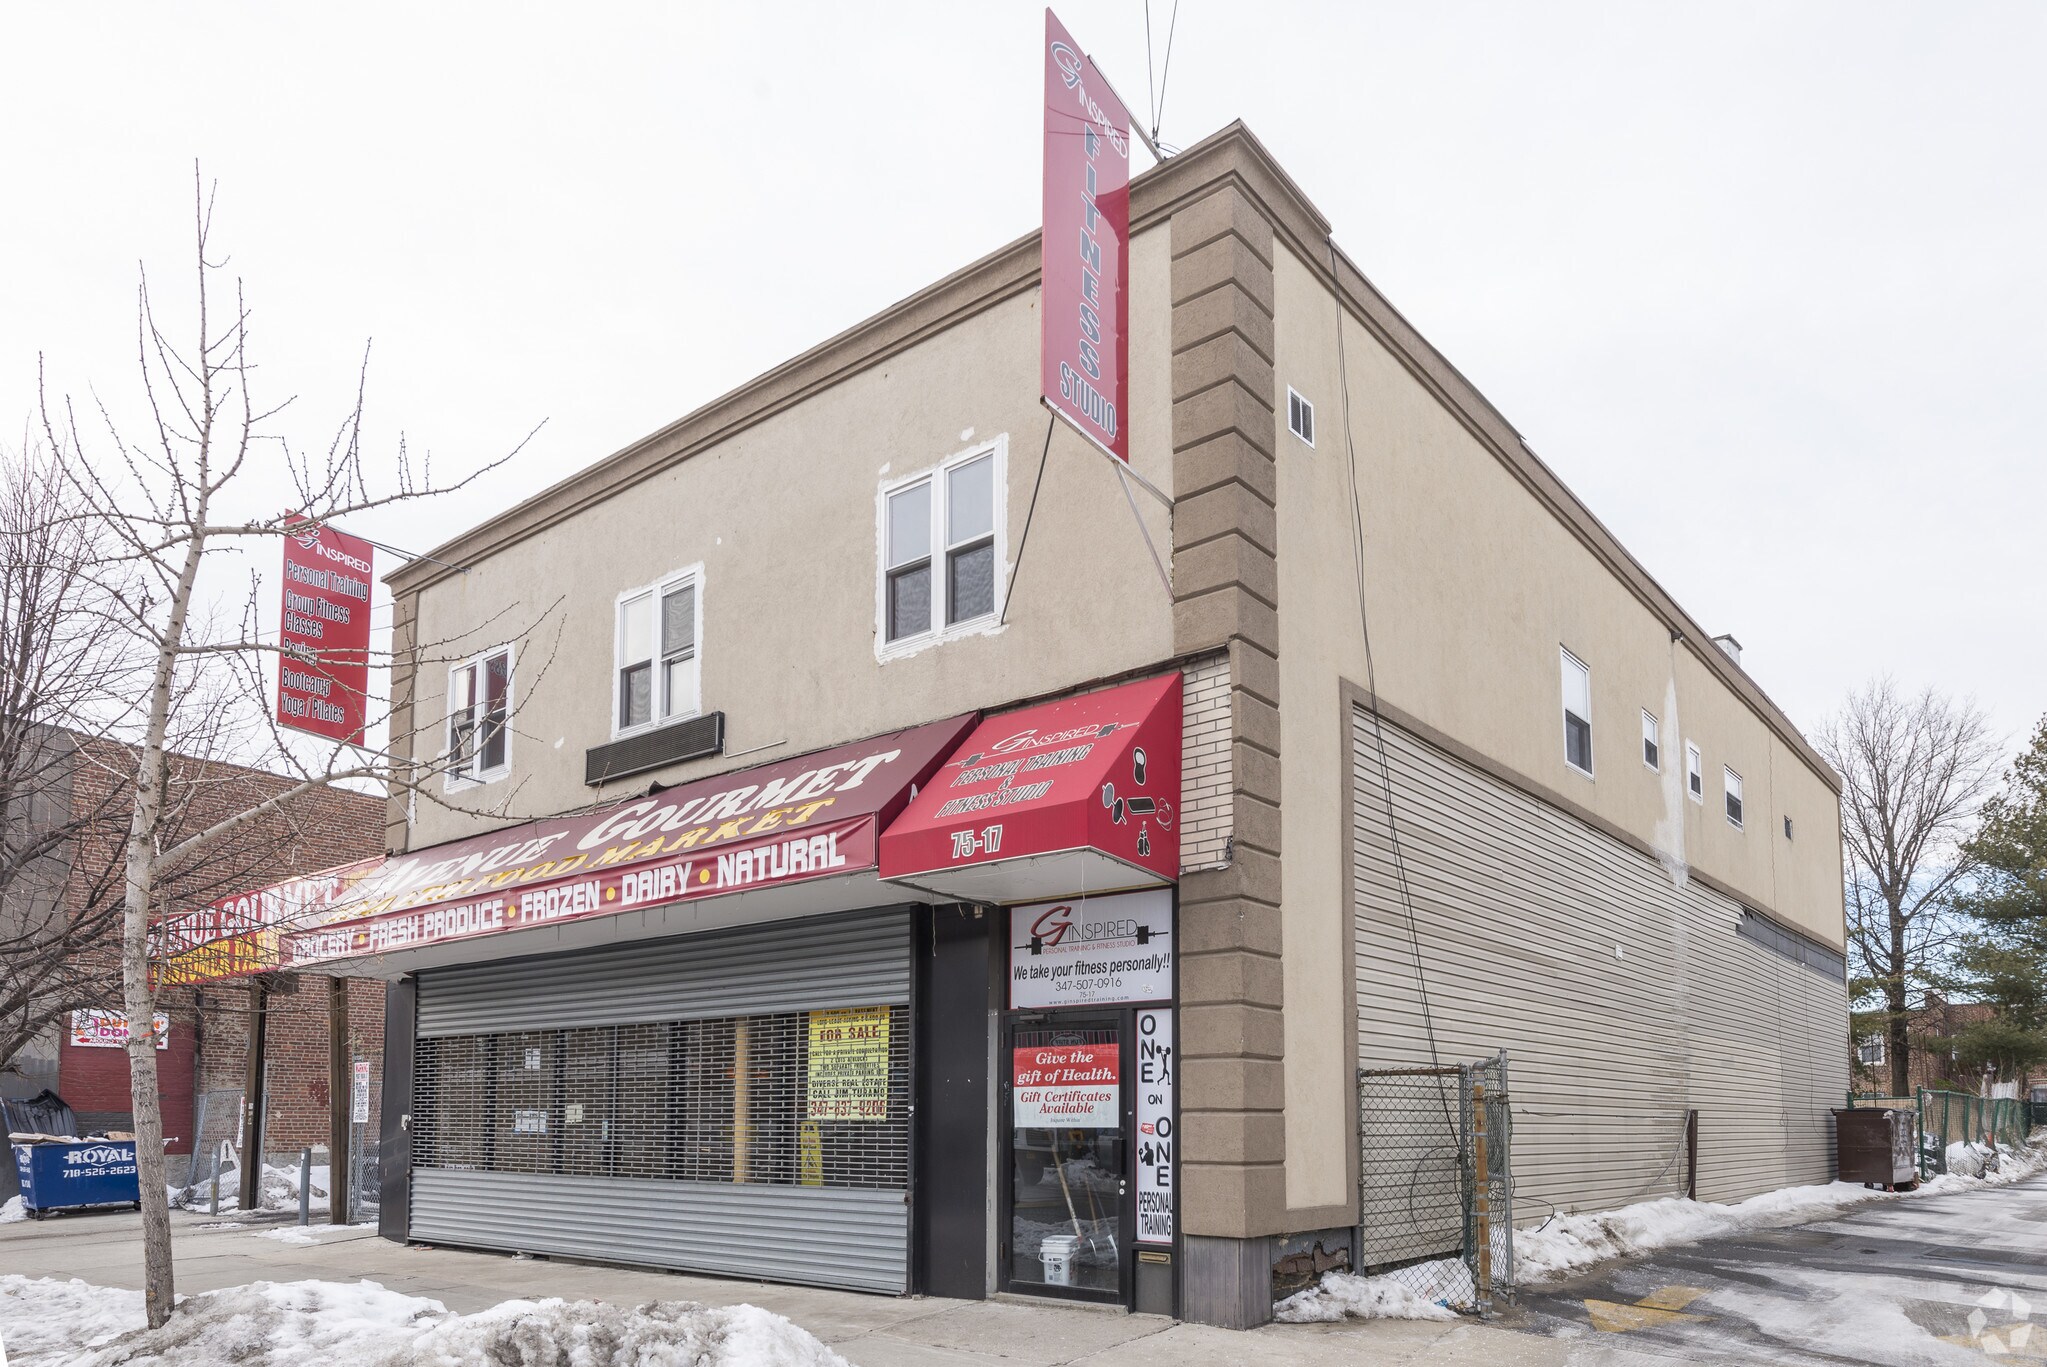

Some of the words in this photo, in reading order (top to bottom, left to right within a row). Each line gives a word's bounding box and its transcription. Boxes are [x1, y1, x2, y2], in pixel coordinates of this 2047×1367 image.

[1079, 122, 1101, 381] FITNESS
[1060, 361, 1117, 438] STUDIO
[286, 559, 329, 589] Personal
[330, 570, 369, 602] Training
[286, 589, 315, 616] Group
[316, 596, 350, 624] Fitness
[285, 611, 323, 638] Classes
[282, 667, 331, 697] Bootcamp
[281, 692, 304, 718] Yoga
[312, 699, 345, 724] Pilates
[950, 758, 1025, 788] PERSONAL
[1021, 743, 1095, 772] TRAINING
[998, 775, 1014, 790] &
[935, 792, 998, 818] FITNESS
[993, 779, 1055, 807] STUDIO
[340, 831, 570, 905] AVENUE
[577, 749, 901, 850] GOURMET
[586, 798, 836, 868] MARKET
[951, 824, 1003, 858] 75-17
[293, 927, 354, 963] GROCERY
[369, 915, 419, 950] FRESH
[423, 899, 503, 940] PRODUCE
[521, 880, 600, 922] FROZEN
[621, 862, 693, 906] DAIRY
[717, 832, 845, 888] NATURAL
[1043, 946, 1067, 954] PERSONAL
[1068, 944, 1091, 953] TRAINING
[1097, 941, 1116, 950] FITNESS
[1117, 940, 1136, 949] STUDIO
[1014, 965, 1028, 981] We
[1030, 963, 1050, 979] take
[1050, 964, 1073, 981] your
[1074, 960, 1108, 976] fitness
[1110, 953, 1170, 976] personally!!
[1056, 977, 1122, 992] 347-507-0916
[1049, 995, 1130, 1005] www.ginspiredtraining.com
[820, 1029, 842, 1042] FOR
[848, 1025, 879, 1039] SALE
[1036, 1052, 1067, 1065] Give
[1070, 1051, 1094, 1063] the
[1140, 1014, 1156, 1083] ONE
[862, 1078, 886, 1086] ESTATE
[1017, 1070, 1042, 1085] gift
[1044, 1069, 1061, 1084] of
[1062, 1068, 1116, 1081] Health.
[813, 1089, 831, 1098] CALL
[834, 1089, 848, 1098] JIM
[1021, 1091, 1041, 1103] Gift
[1045, 1091, 1112, 1102] Certificates
[1148, 1094, 1162, 1105] ON
[1039, 1103, 1094, 1114] Available
[68, 1149, 133, 1164] ROYAL
[1156, 1117, 1172, 1187] ONE
[63, 1166, 136, 1178] 718-526-2623
[1139, 1191, 1172, 1214] PERSONAL
[1140, 1213, 1172, 1236] TRAINING
